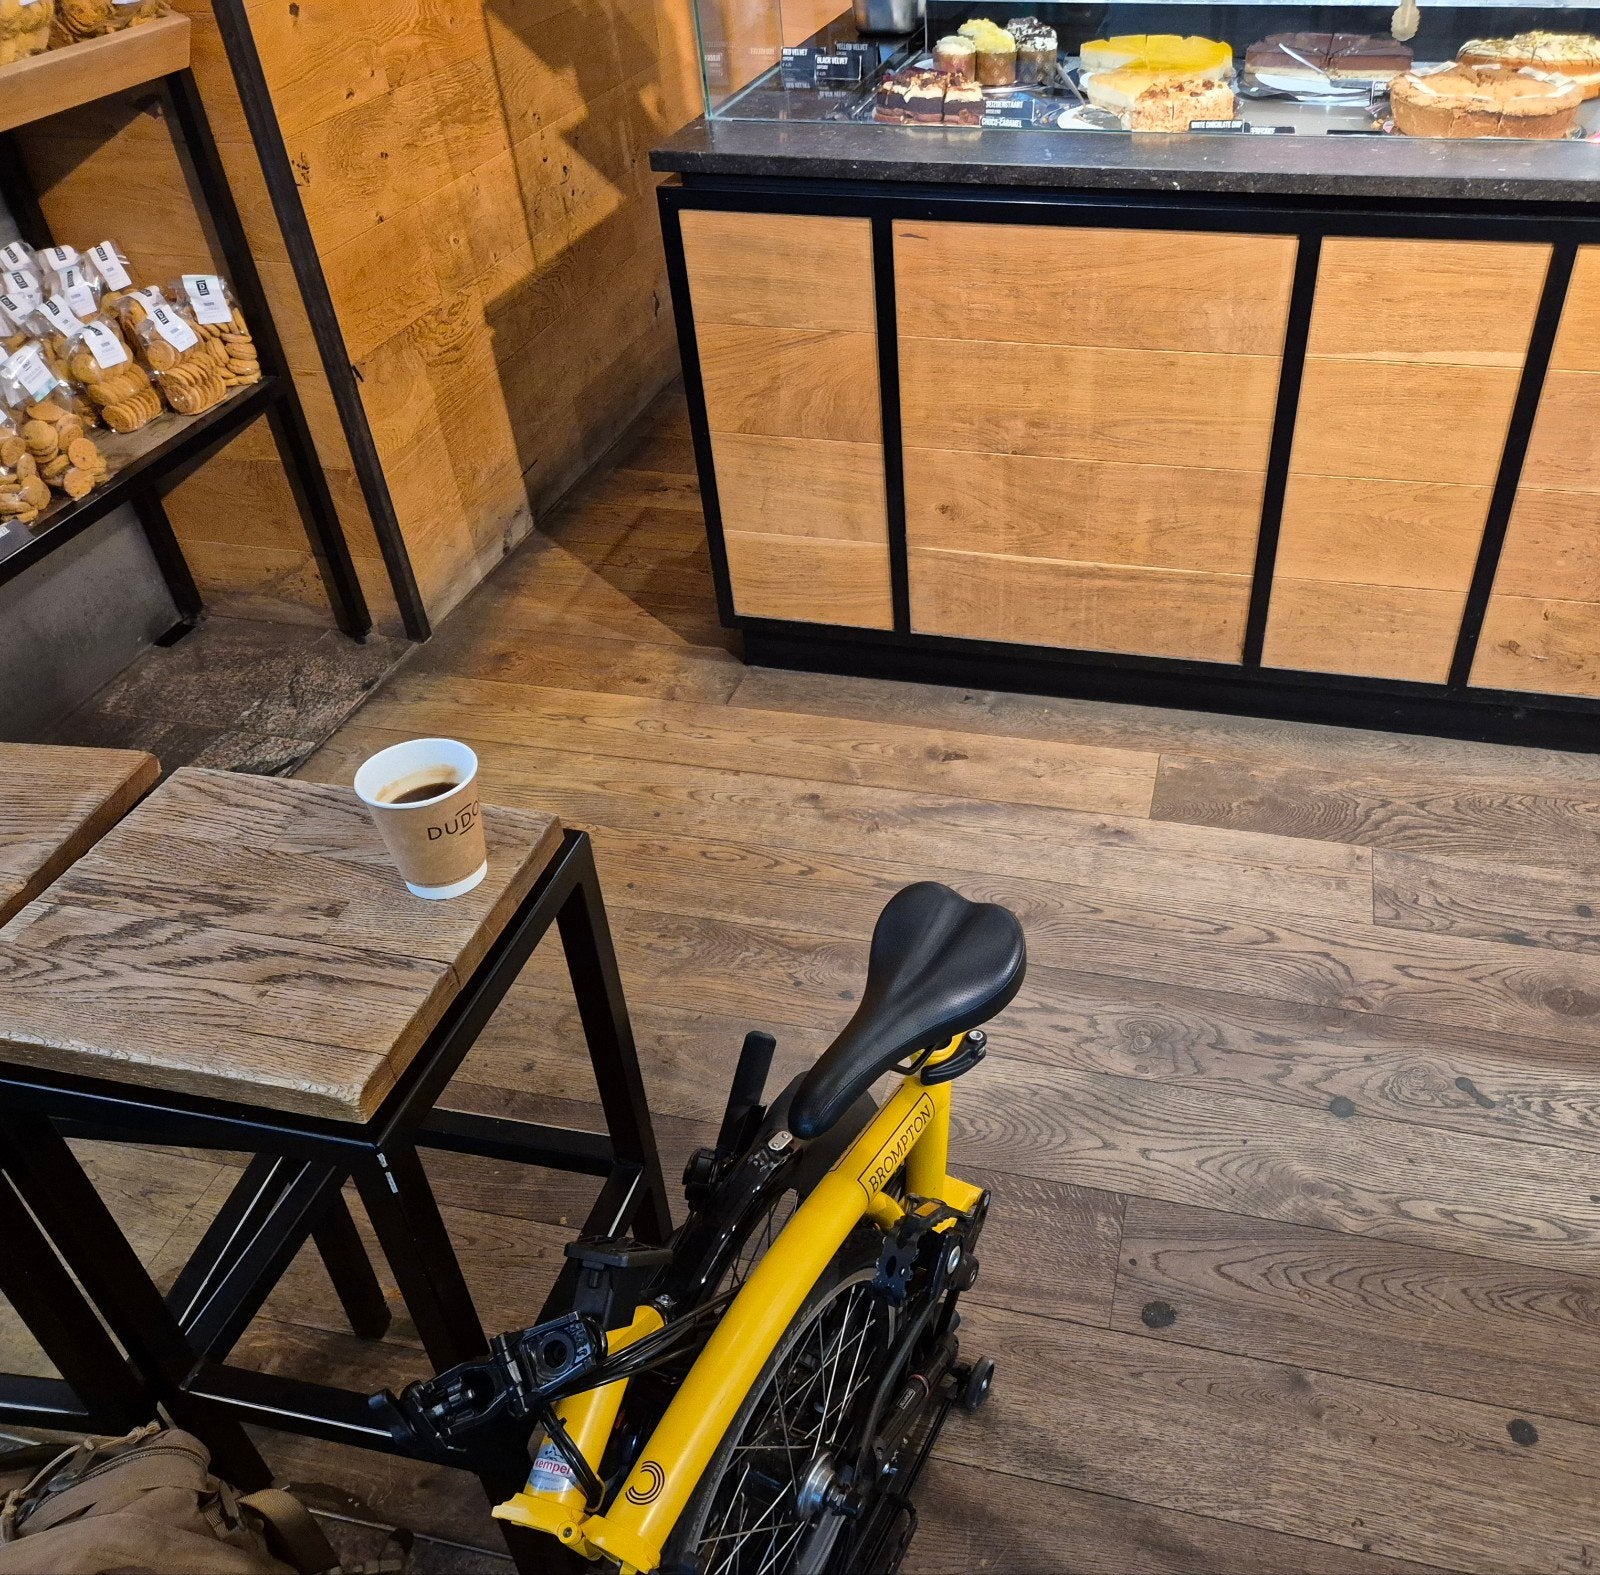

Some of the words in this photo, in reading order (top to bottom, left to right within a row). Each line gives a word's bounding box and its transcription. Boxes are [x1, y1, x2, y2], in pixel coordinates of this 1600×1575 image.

[816, 56, 831, 64] BLACK
[832, 57, 848, 65] VELVET
[868, 1104, 931, 1193] BROMPTON
